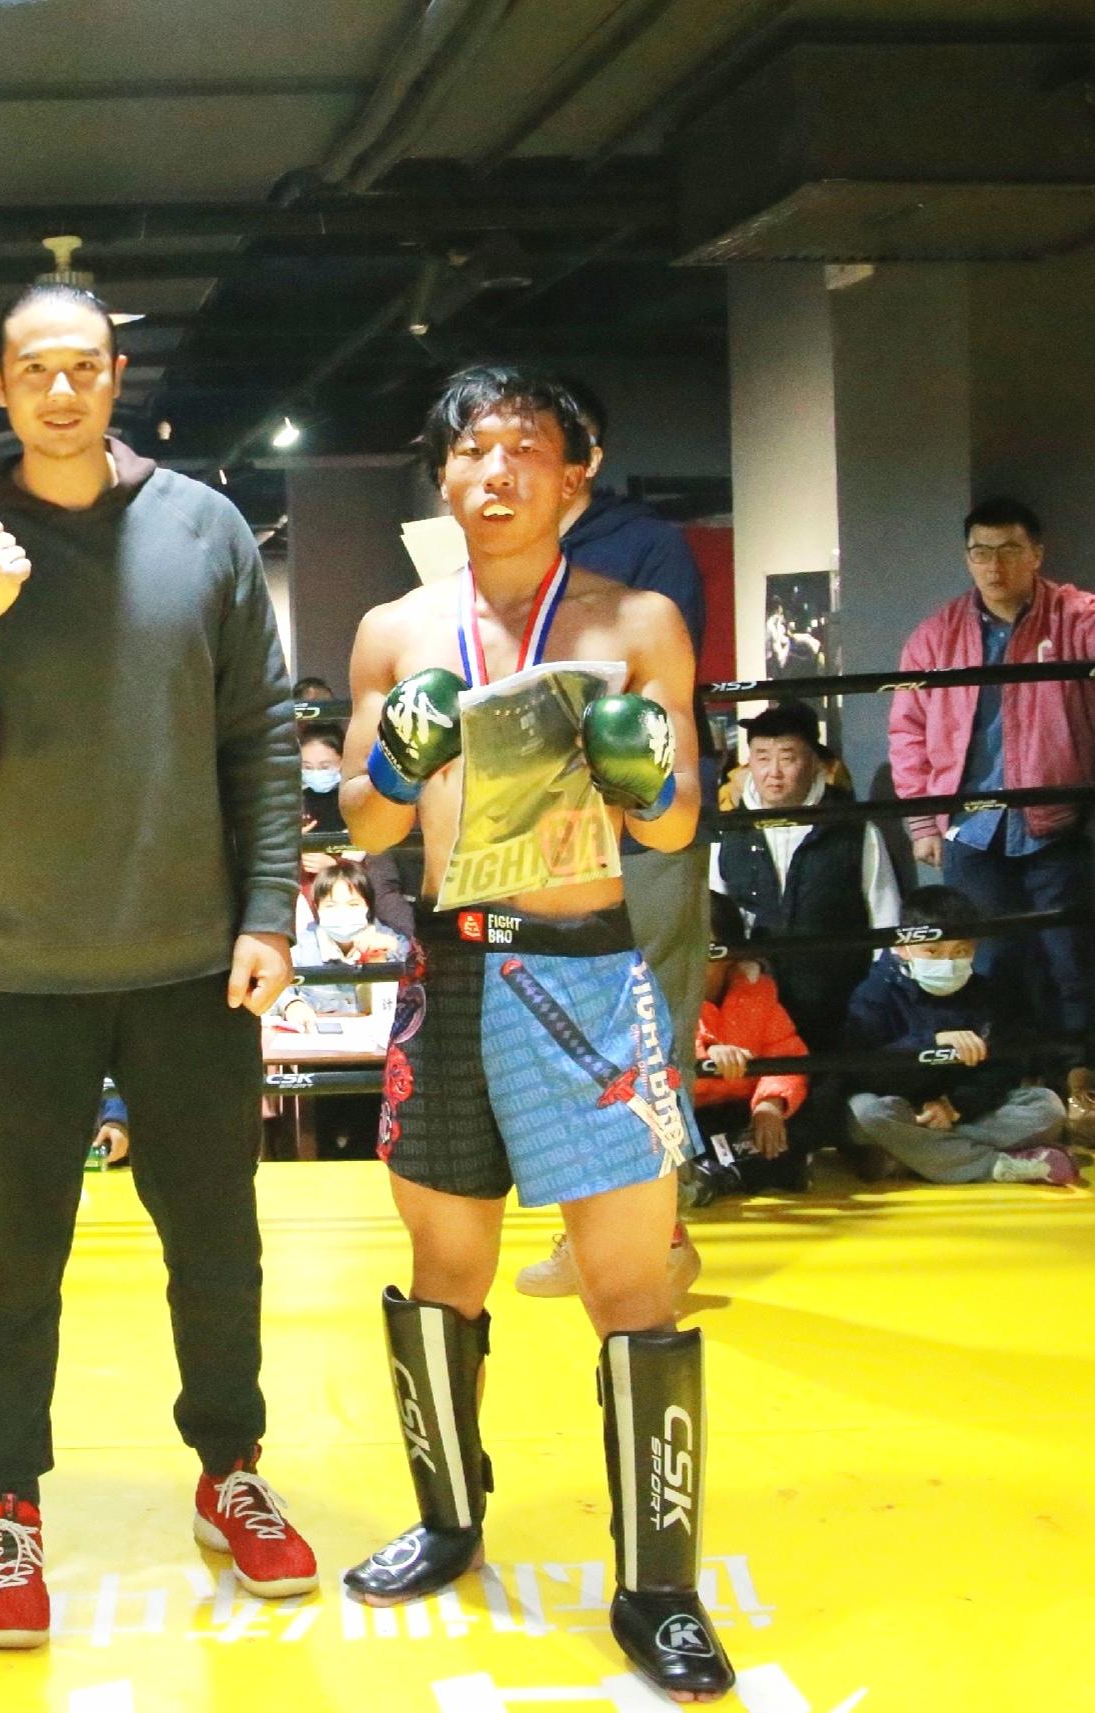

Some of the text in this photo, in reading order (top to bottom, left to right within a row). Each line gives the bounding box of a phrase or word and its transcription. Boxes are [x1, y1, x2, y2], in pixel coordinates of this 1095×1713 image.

[488, 913, 522, 931] FIGHT
[488, 928, 513, 944] BRO
[895, 928, 943, 944] CSK
[265, 1073, 315, 1085] CSK
[391, 1356, 437, 1474] CSK
[663, 1404, 693, 1536] CSK
[650, 1436, 663, 1531] SPORT
